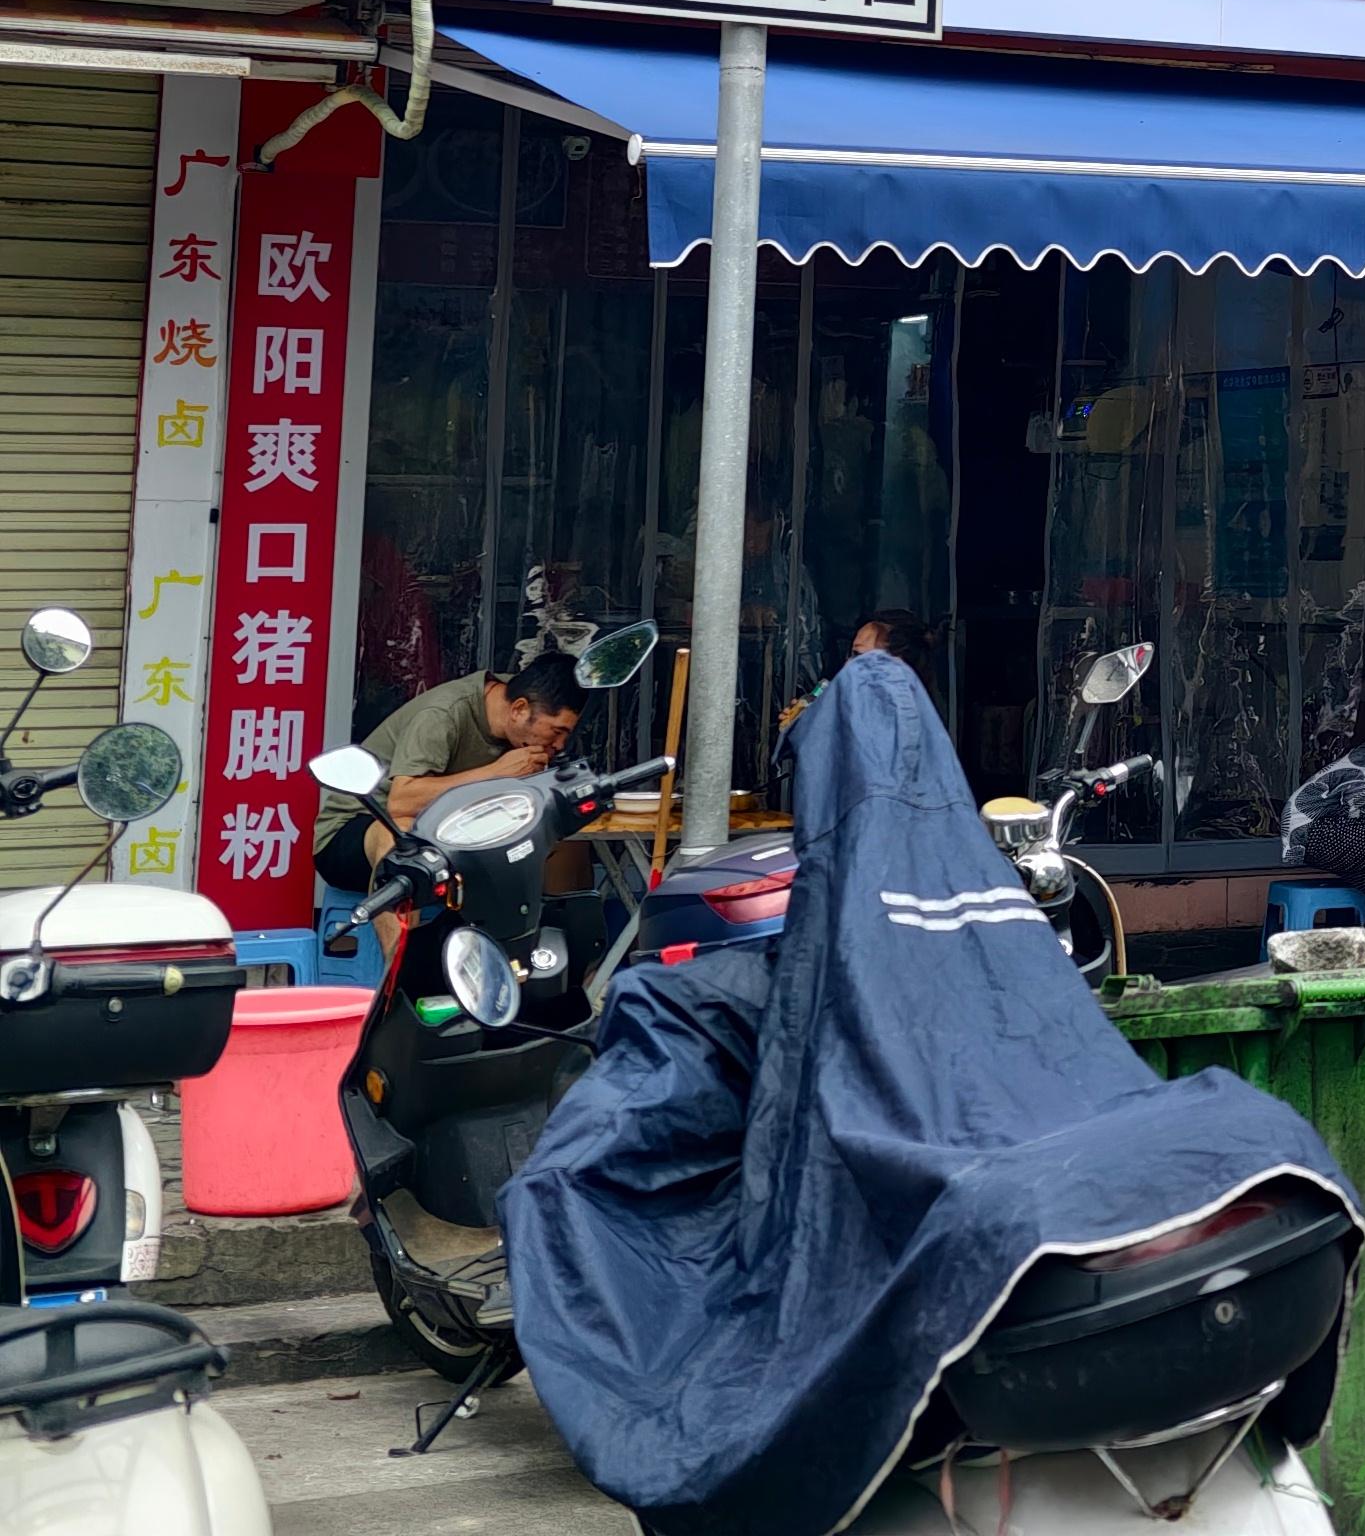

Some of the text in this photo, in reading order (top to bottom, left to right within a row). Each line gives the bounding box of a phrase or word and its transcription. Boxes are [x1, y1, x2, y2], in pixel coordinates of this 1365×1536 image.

[153, 147, 231, 449] 广东烧卤
[220, 230, 333, 882] 欧阳爽口猪脚粉
[129, 569, 204, 876] 广东卤
